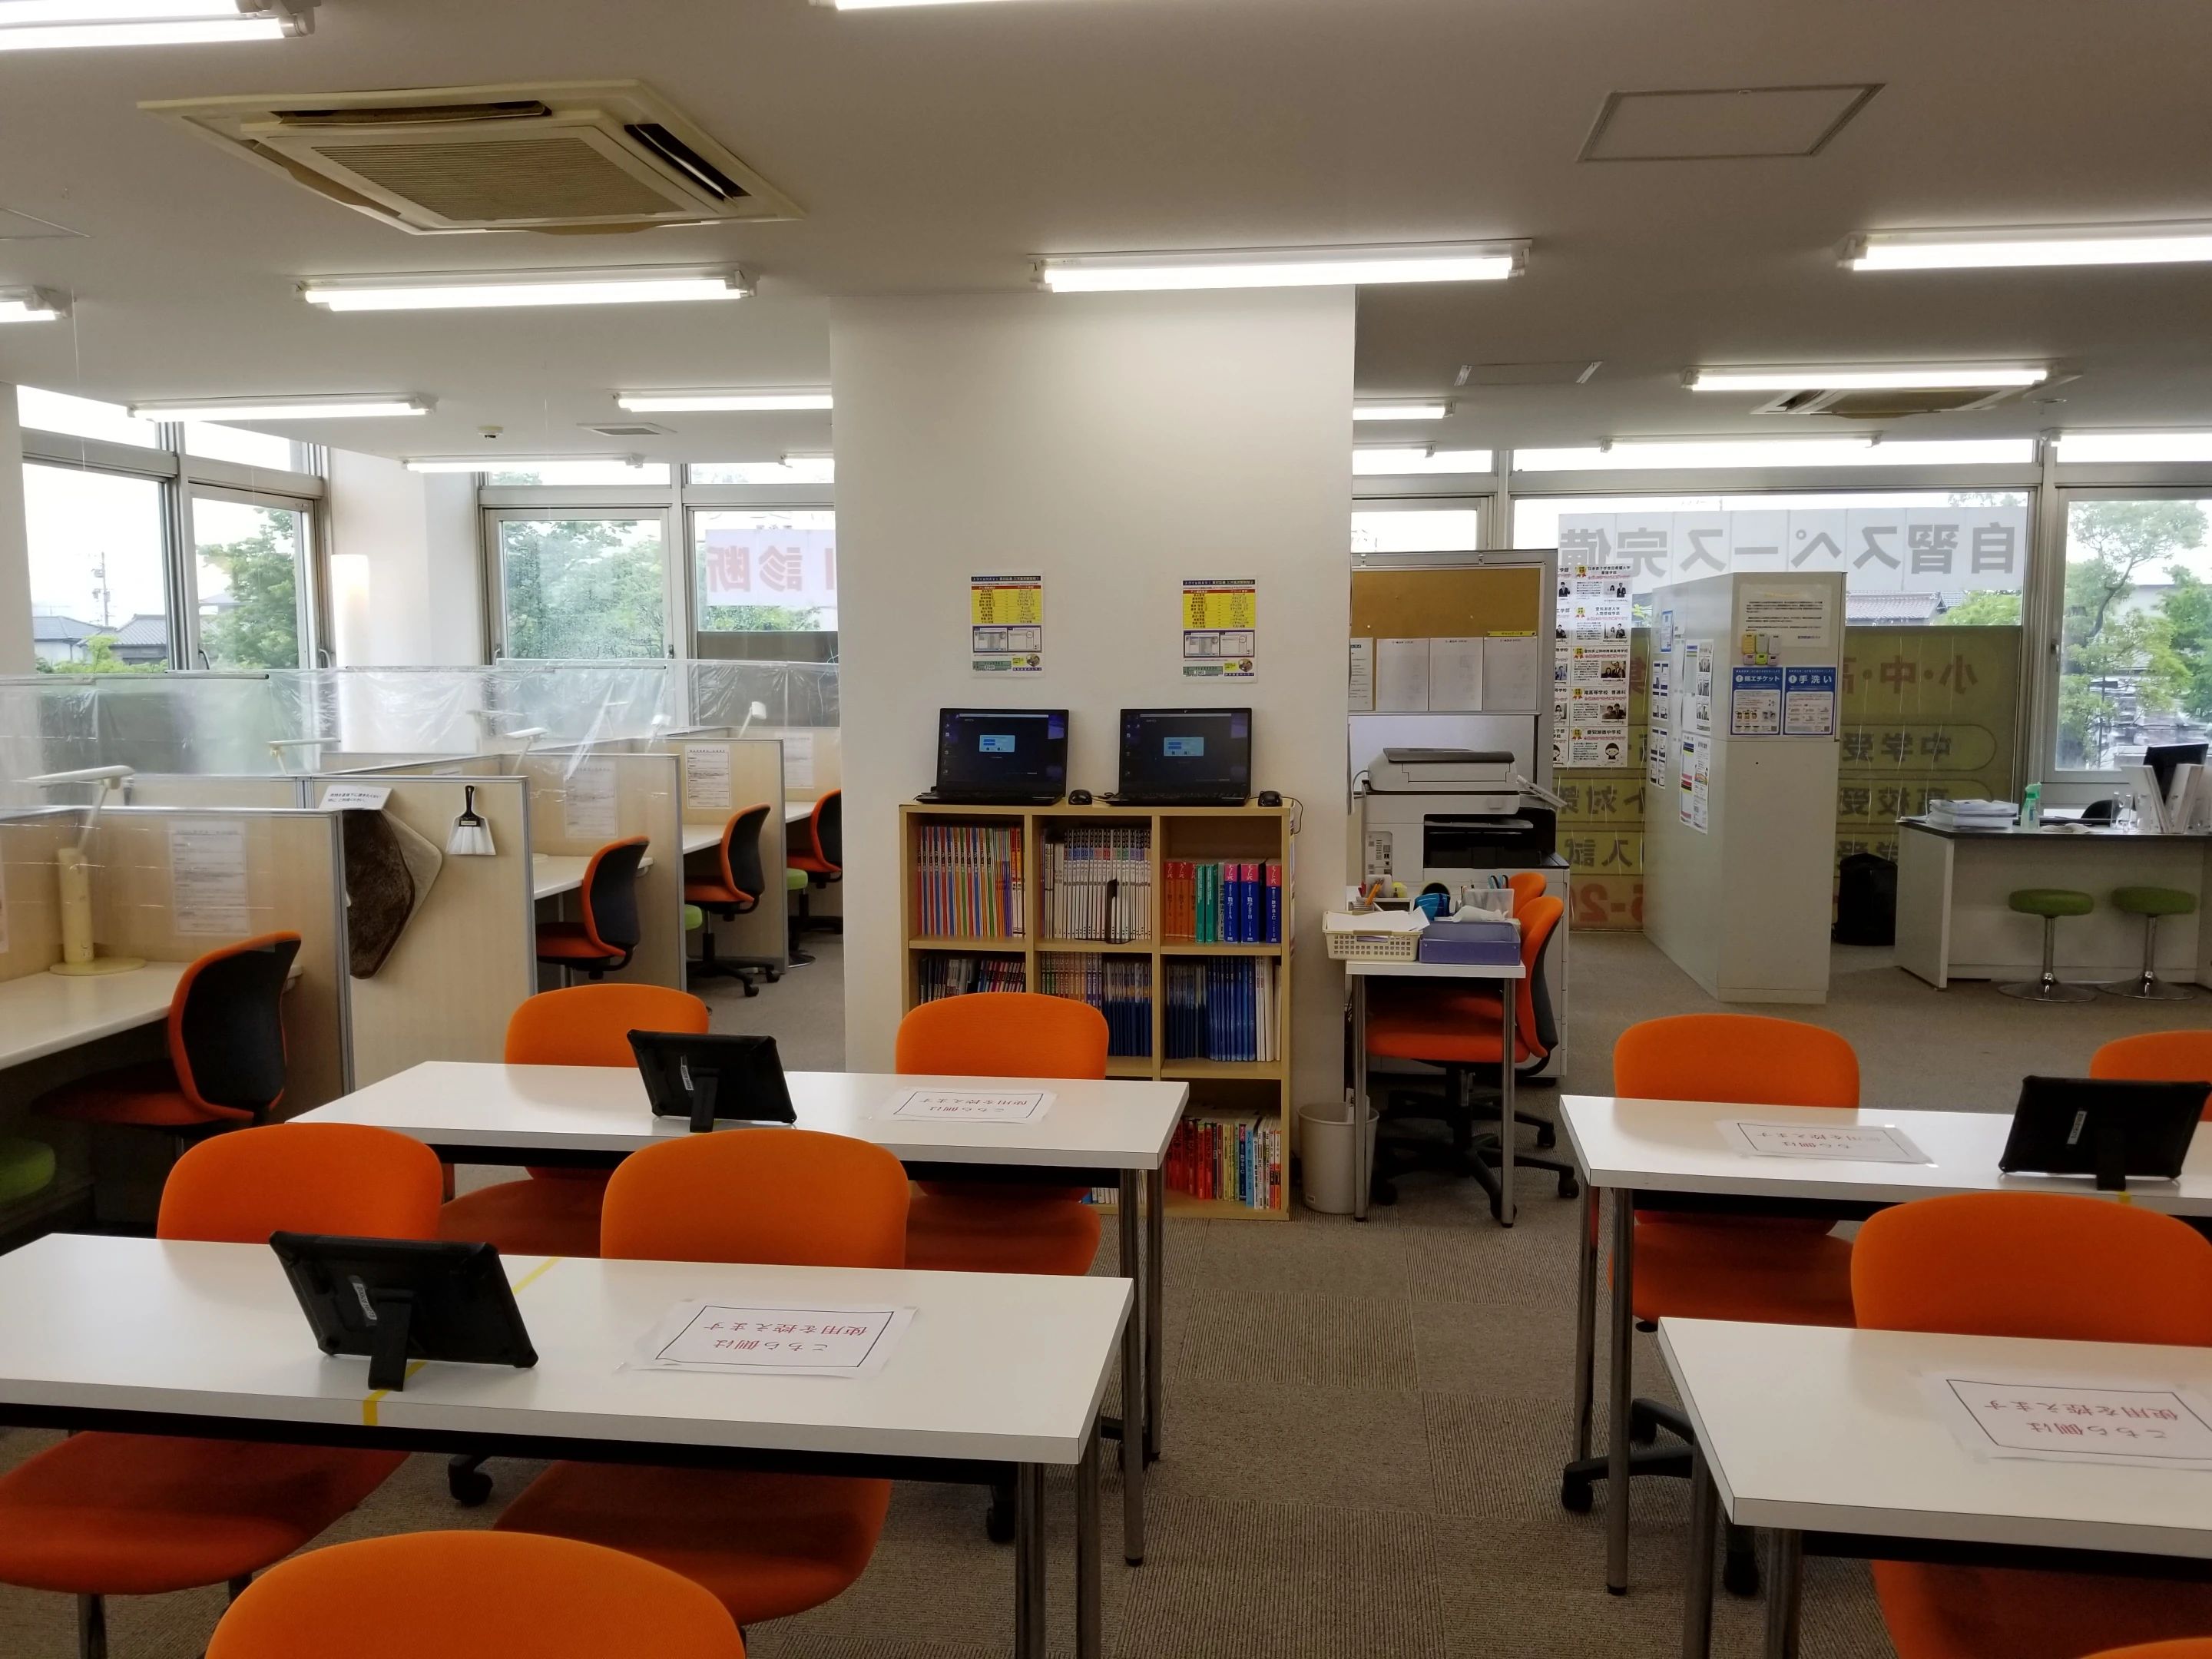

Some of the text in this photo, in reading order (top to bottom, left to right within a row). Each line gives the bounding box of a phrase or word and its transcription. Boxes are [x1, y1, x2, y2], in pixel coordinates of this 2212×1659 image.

[1799, 675, 1833, 684] 手洗い
[702, 1321, 868, 1337] 使用を控えます
[712, 1339, 830, 1352] こちら側は
[1984, 1400, 2179, 1422] 使用を控えます
[2025, 1421, 2168, 1440] こちら側は
